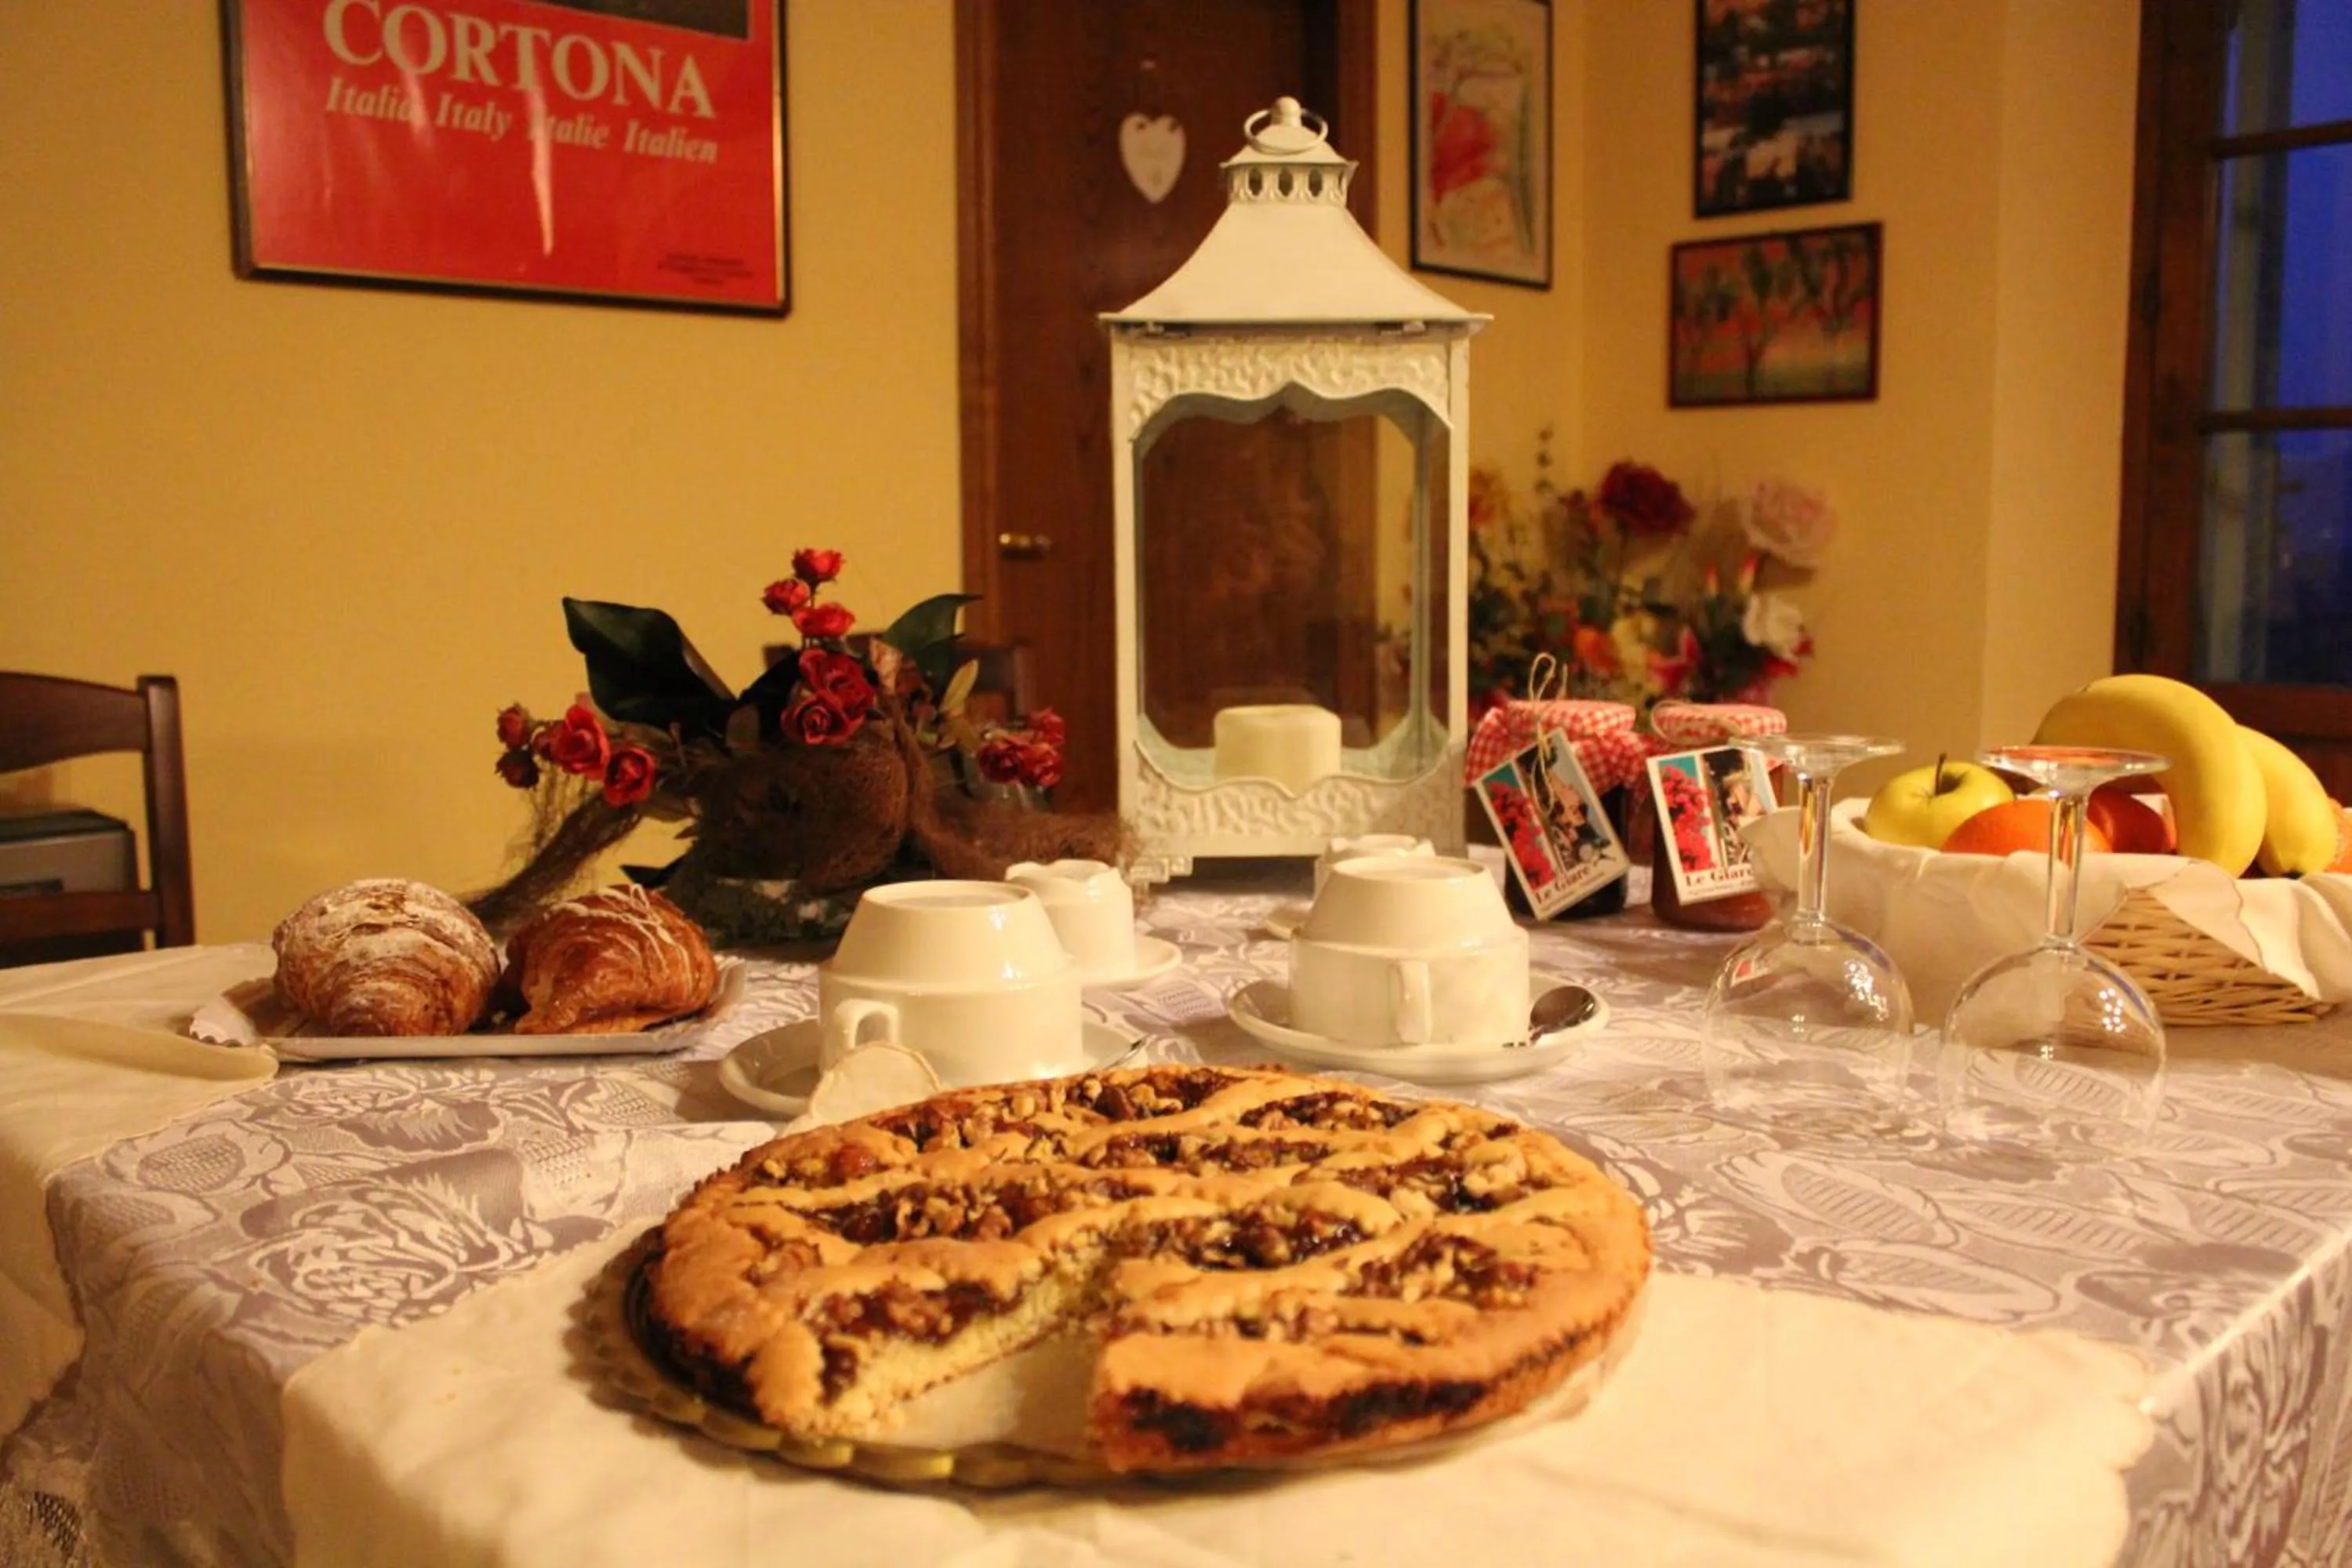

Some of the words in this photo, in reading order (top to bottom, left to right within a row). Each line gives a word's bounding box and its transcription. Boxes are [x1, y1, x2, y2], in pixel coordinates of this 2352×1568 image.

[323, 0, 717, 118] CORTONA
[325, 77, 417, 122] Italia
[436, 92, 511, 142] Italy
[622, 119, 718, 164] Italien
